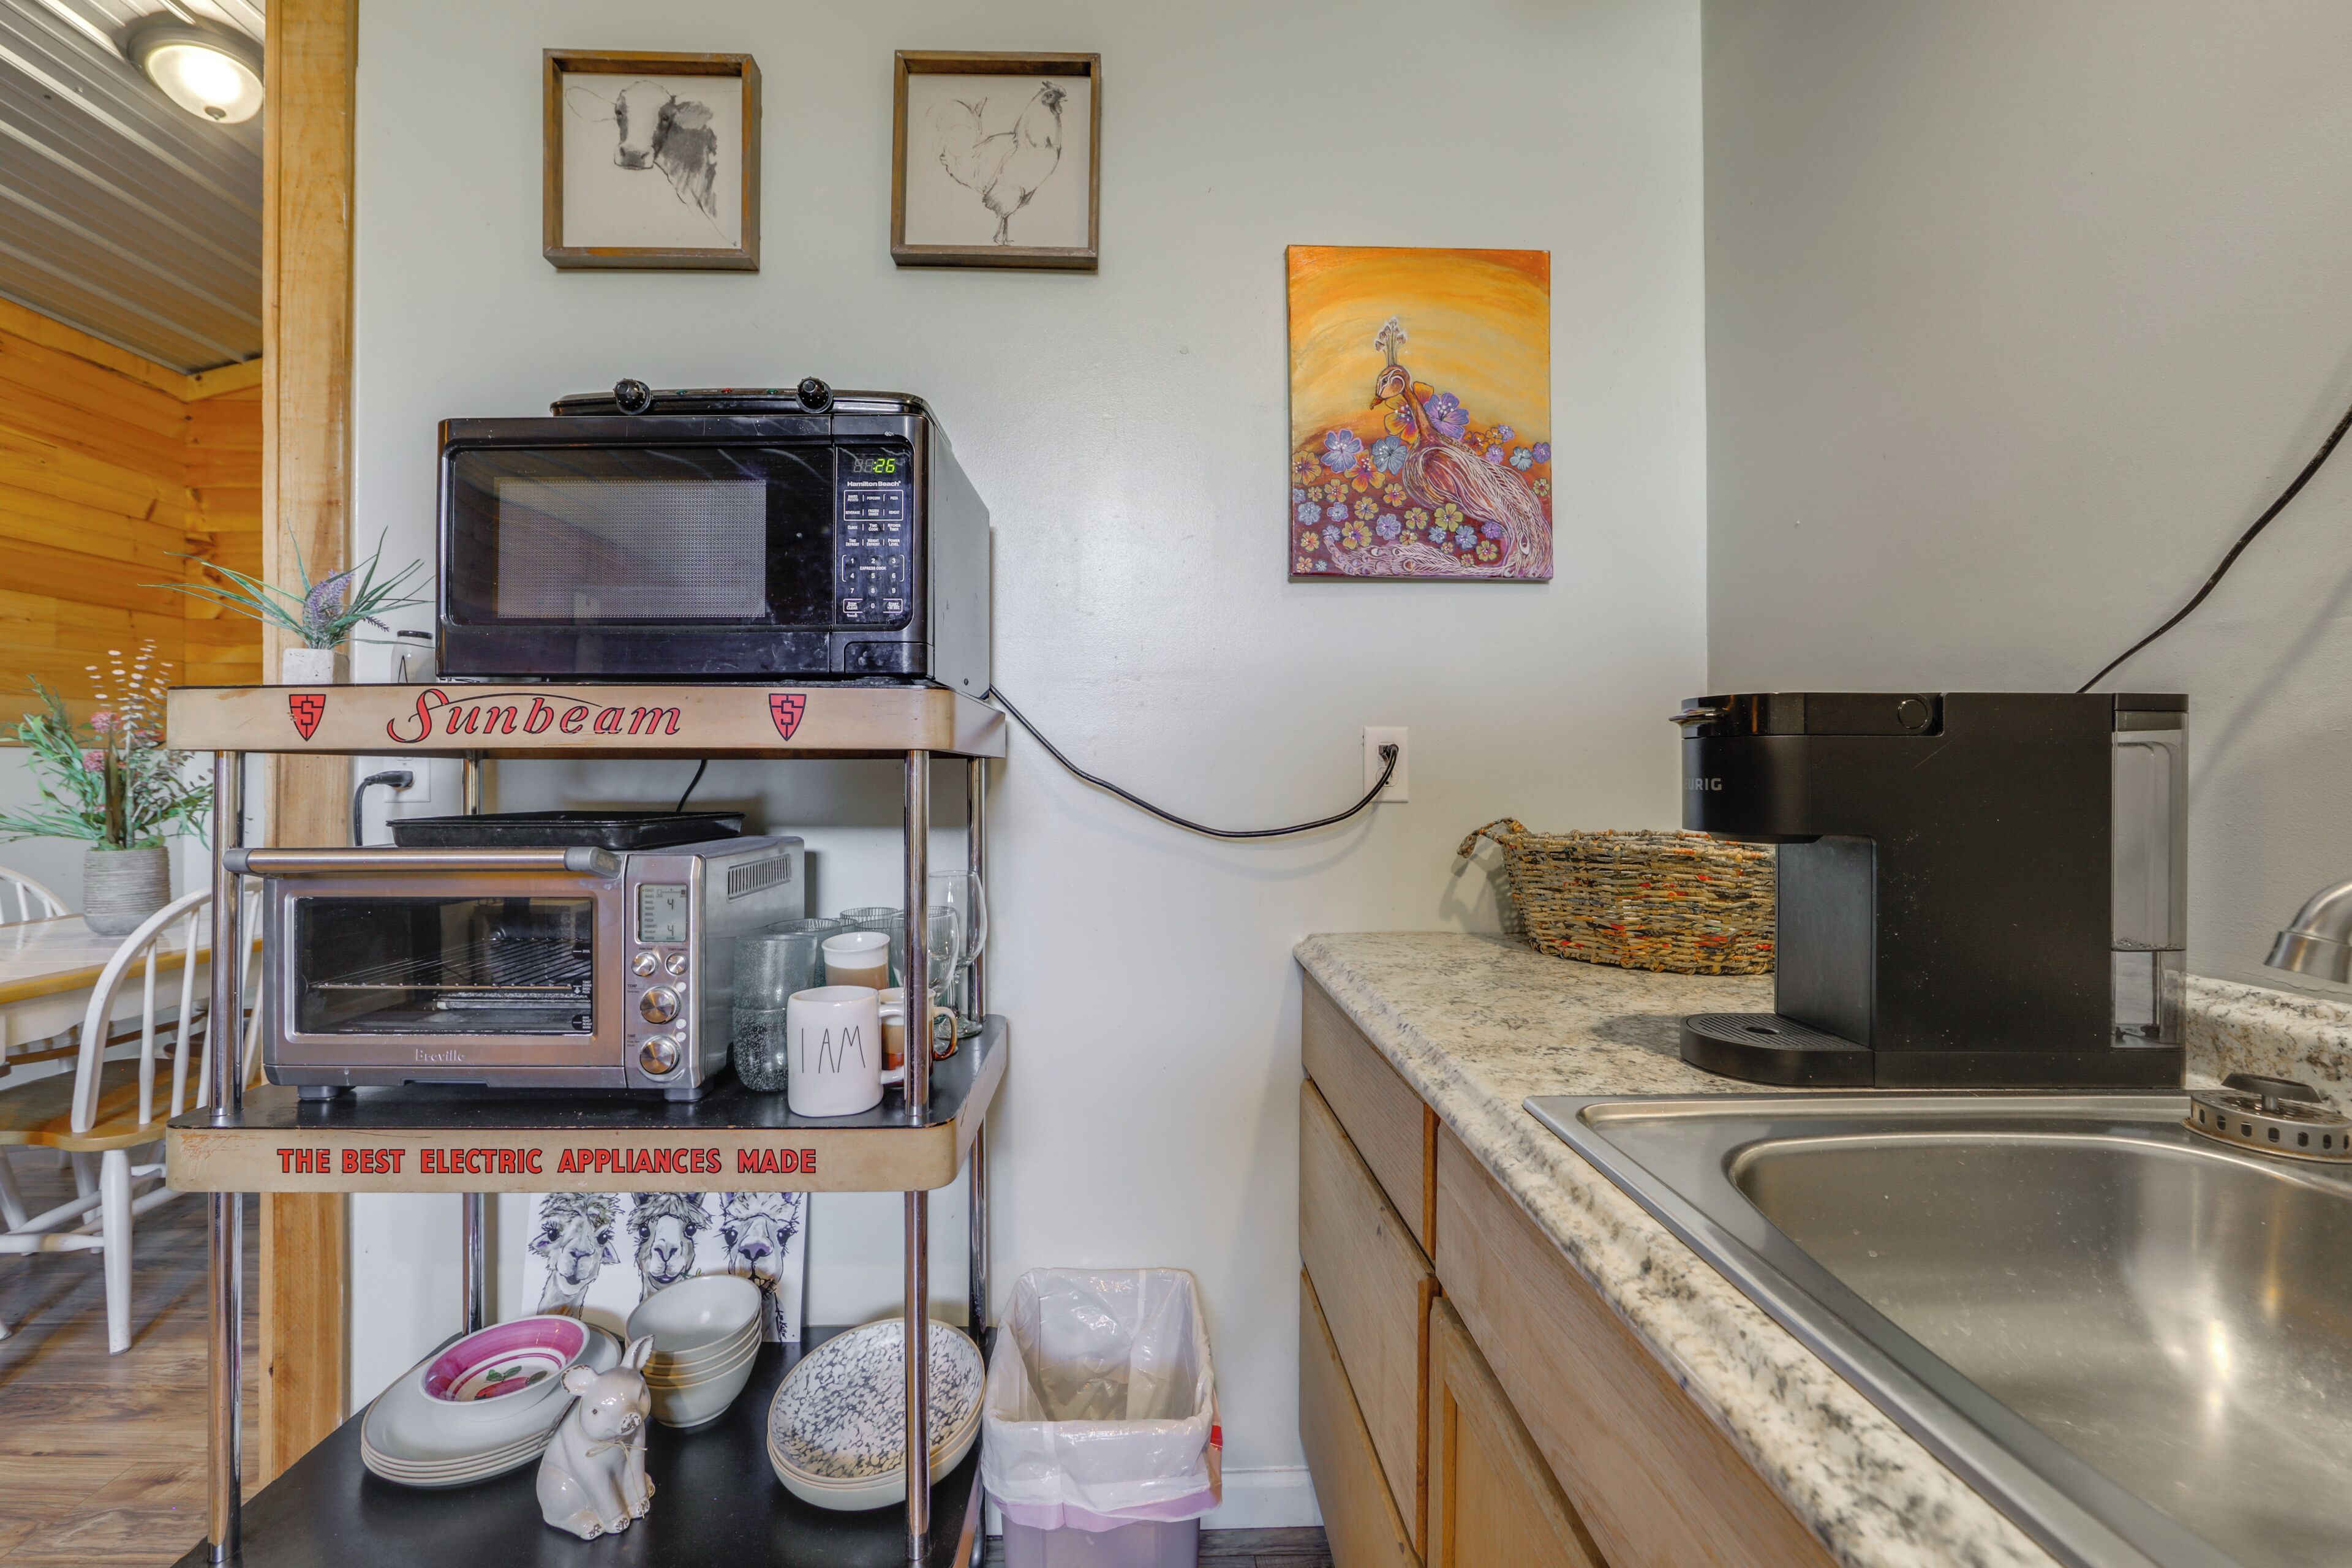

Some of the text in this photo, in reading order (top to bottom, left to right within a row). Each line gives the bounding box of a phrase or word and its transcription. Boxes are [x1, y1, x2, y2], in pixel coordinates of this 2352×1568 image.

[387, 688, 680, 743] Sunbeam
[667, 899, 674, 910] 4
[667, 925, 674, 937] 4
[416, 1049, 465, 1061] Breville
[818, 1025, 865, 1074] AM
[276, 1148, 816, 1174] THE BEST ELECTRIC APPLIANCES MADE
